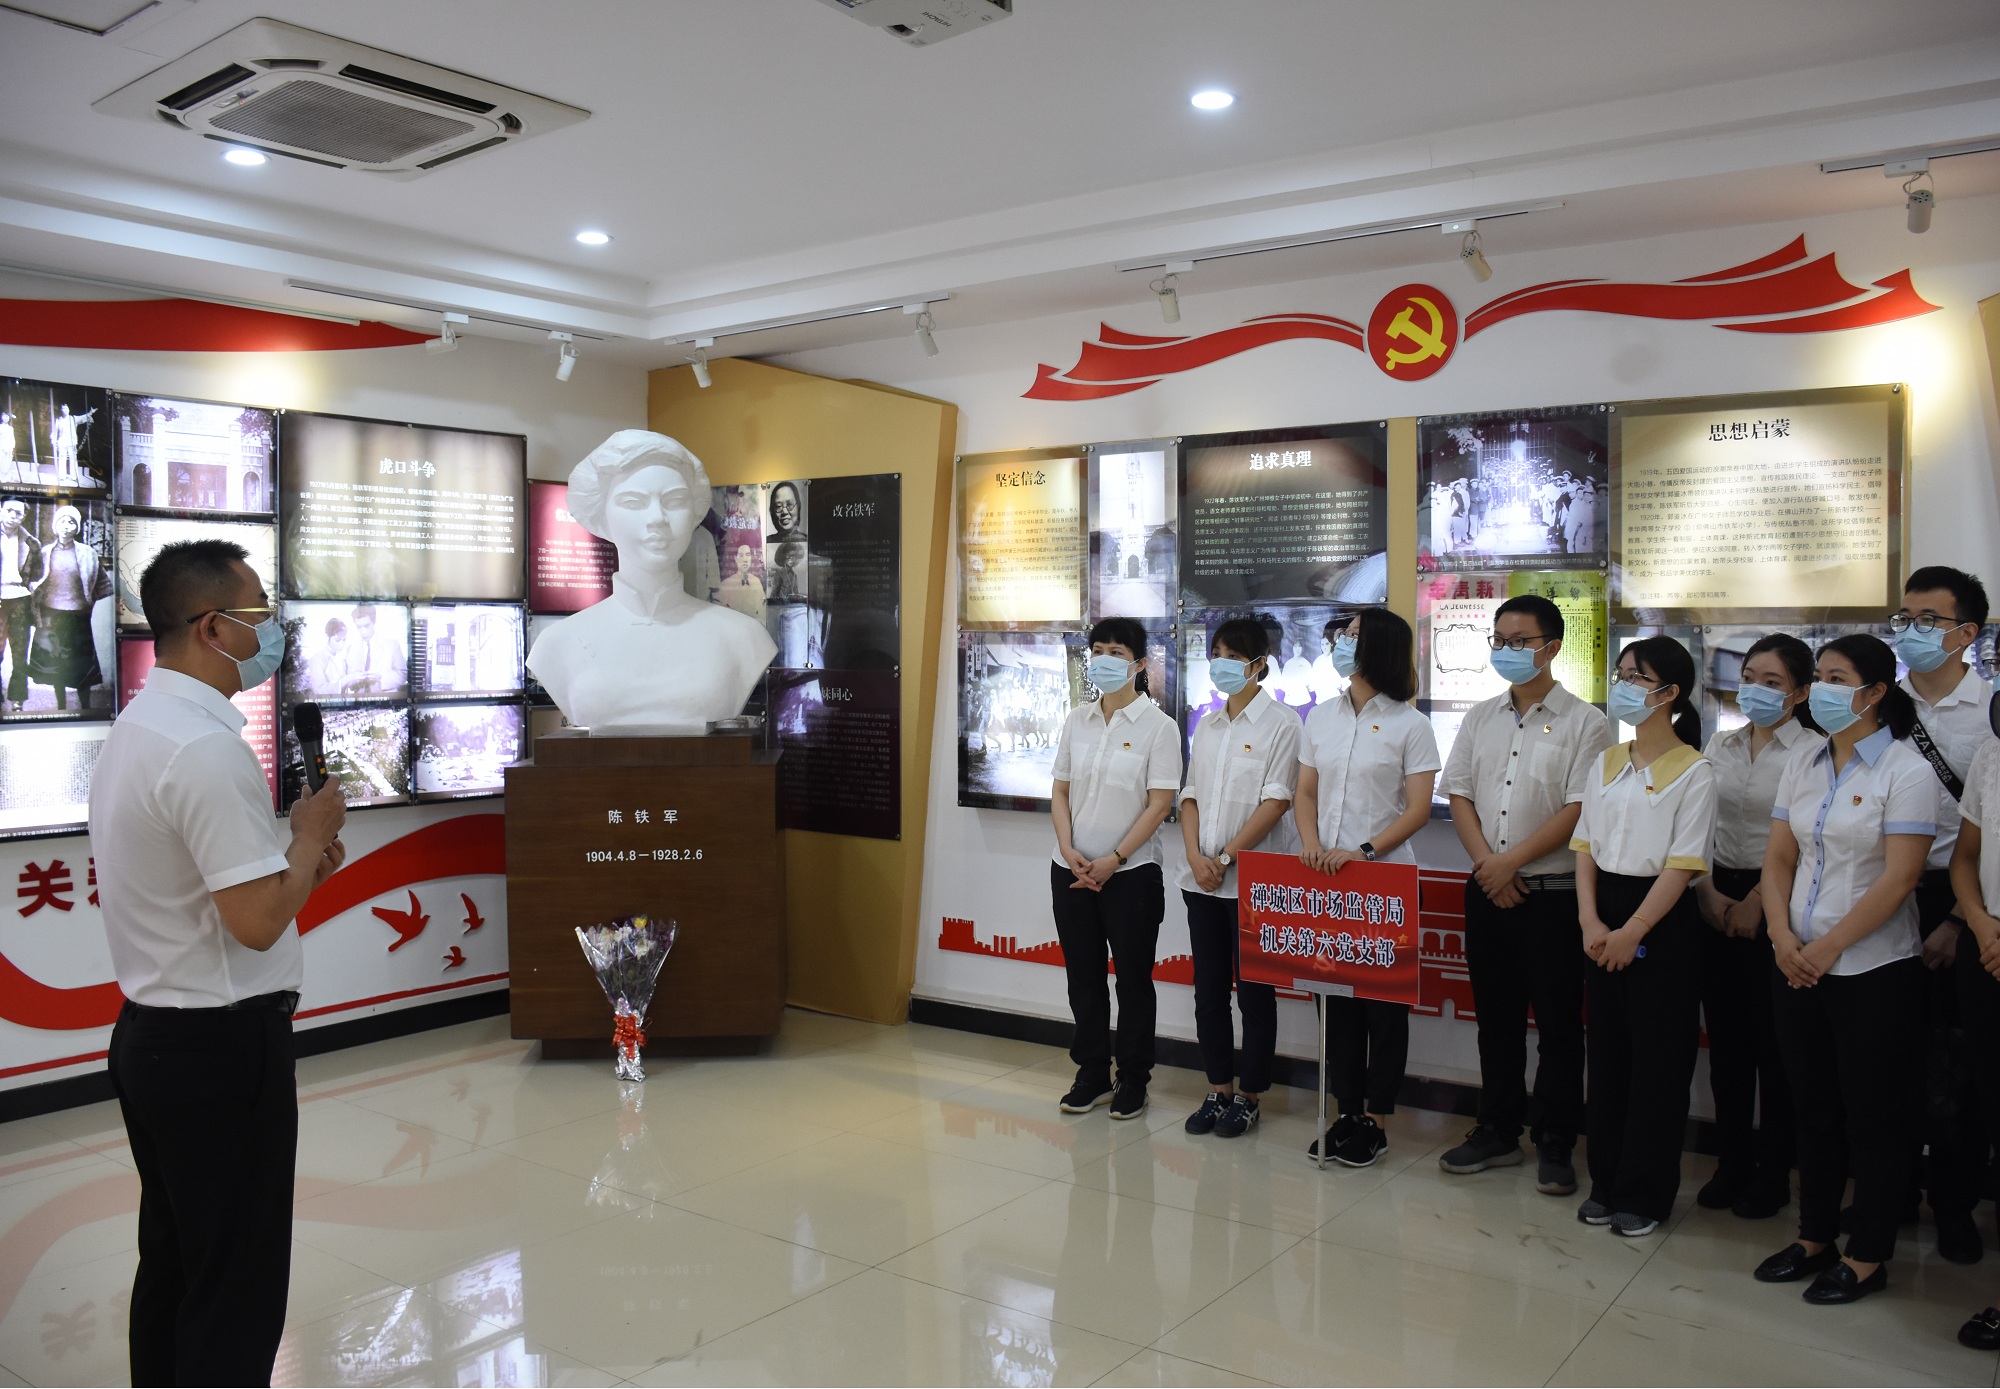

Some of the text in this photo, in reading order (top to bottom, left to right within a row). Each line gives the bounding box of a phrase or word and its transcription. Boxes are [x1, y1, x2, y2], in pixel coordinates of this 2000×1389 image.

[1709, 418, 1791, 441] 思想启蒙
[379, 457, 437, 478] 虎口斗争
[1249, 450, 1312, 471] 追求真理
[996, 470, 1046, 488] 坚定信念
[832, 502, 875, 518] 改名铁军
[814, 686, 853, 701] 妹同心
[608, 809, 678, 824] 陈铁军
[1250, 882, 1405, 927] 禅城区市场监管局
[1260, 922, 1396, 968] 机关第六党支部
